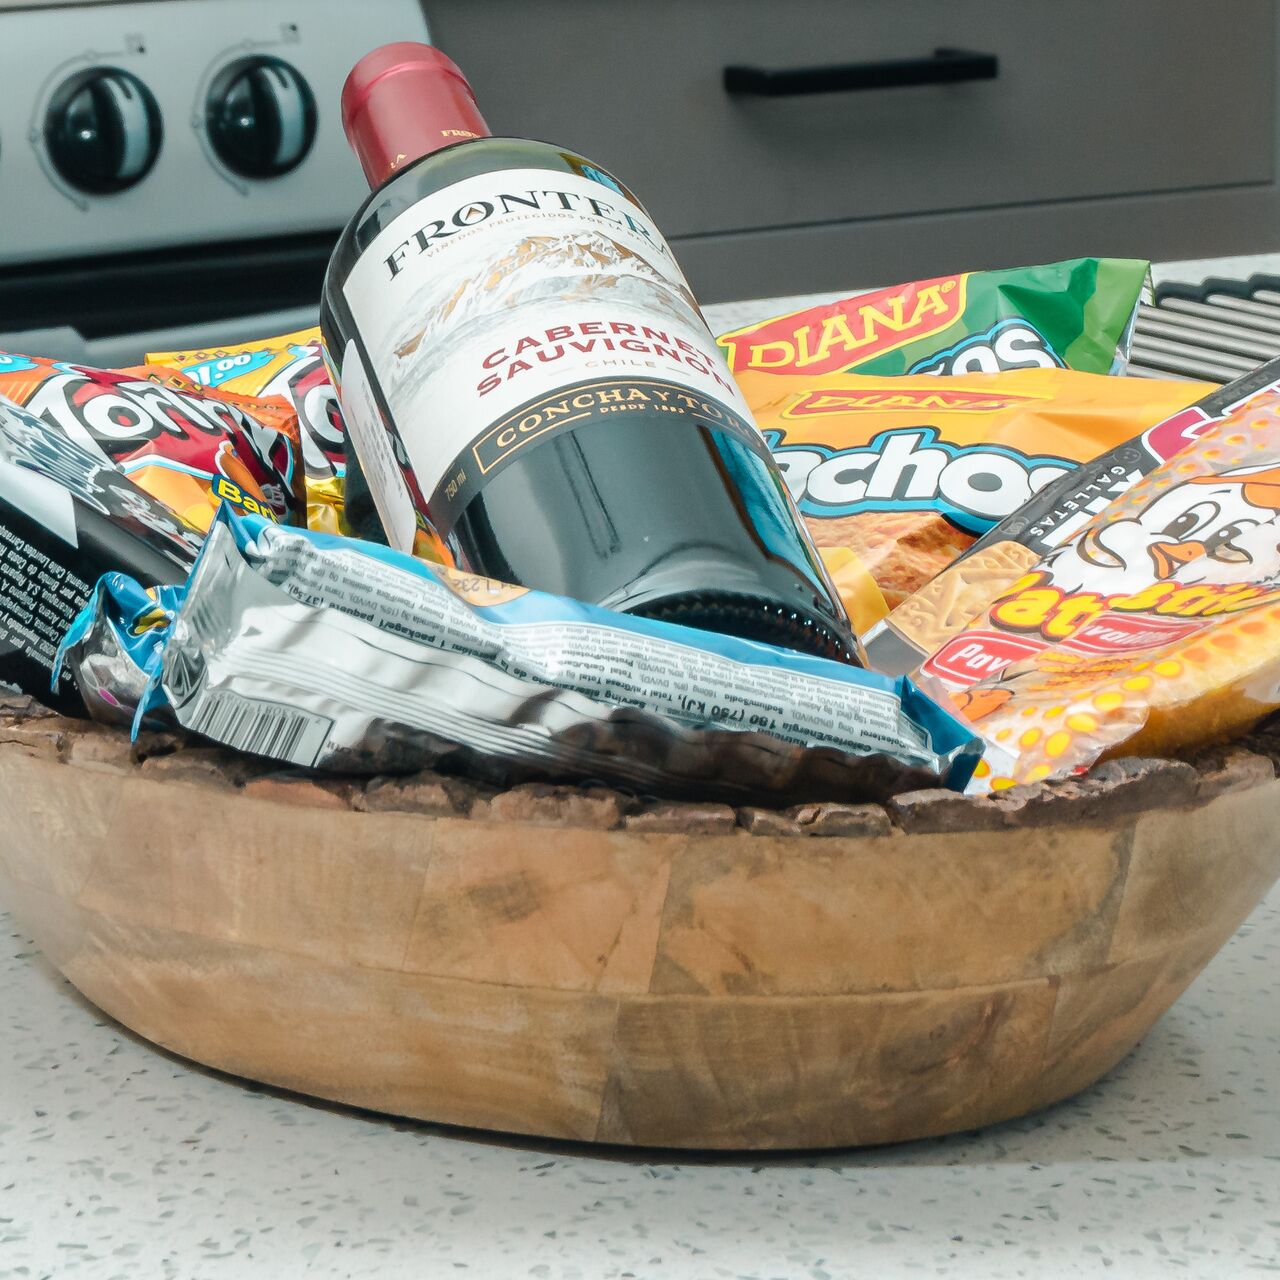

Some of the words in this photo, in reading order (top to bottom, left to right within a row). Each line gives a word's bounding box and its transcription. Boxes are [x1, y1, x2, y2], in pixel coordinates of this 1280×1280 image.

[481, 321, 717, 370] CABERNET
[476, 338, 735, 398] SAUVIGNON
[584, 359, 658, 370] CHILE
[496, 388, 651, 448] CONCHA
[652, 390, 670, 403] Y
[599, 403, 646, 414] DESDE
[444, 480, 459, 502] 750
[1029, 466, 1126, 536] GALLETAS
[4, 550, 27, 570] Costa
[20, 543, 51, 568] Lourdes
[45, 560, 66, 579] Calle
[35, 570, 60, 591] Bimbo
[4, 615, 41, 644] Importado
[578, 672, 602, 683] Total
[603, 690, 646, 709] Serving
[649, 688, 673, 701] Total
